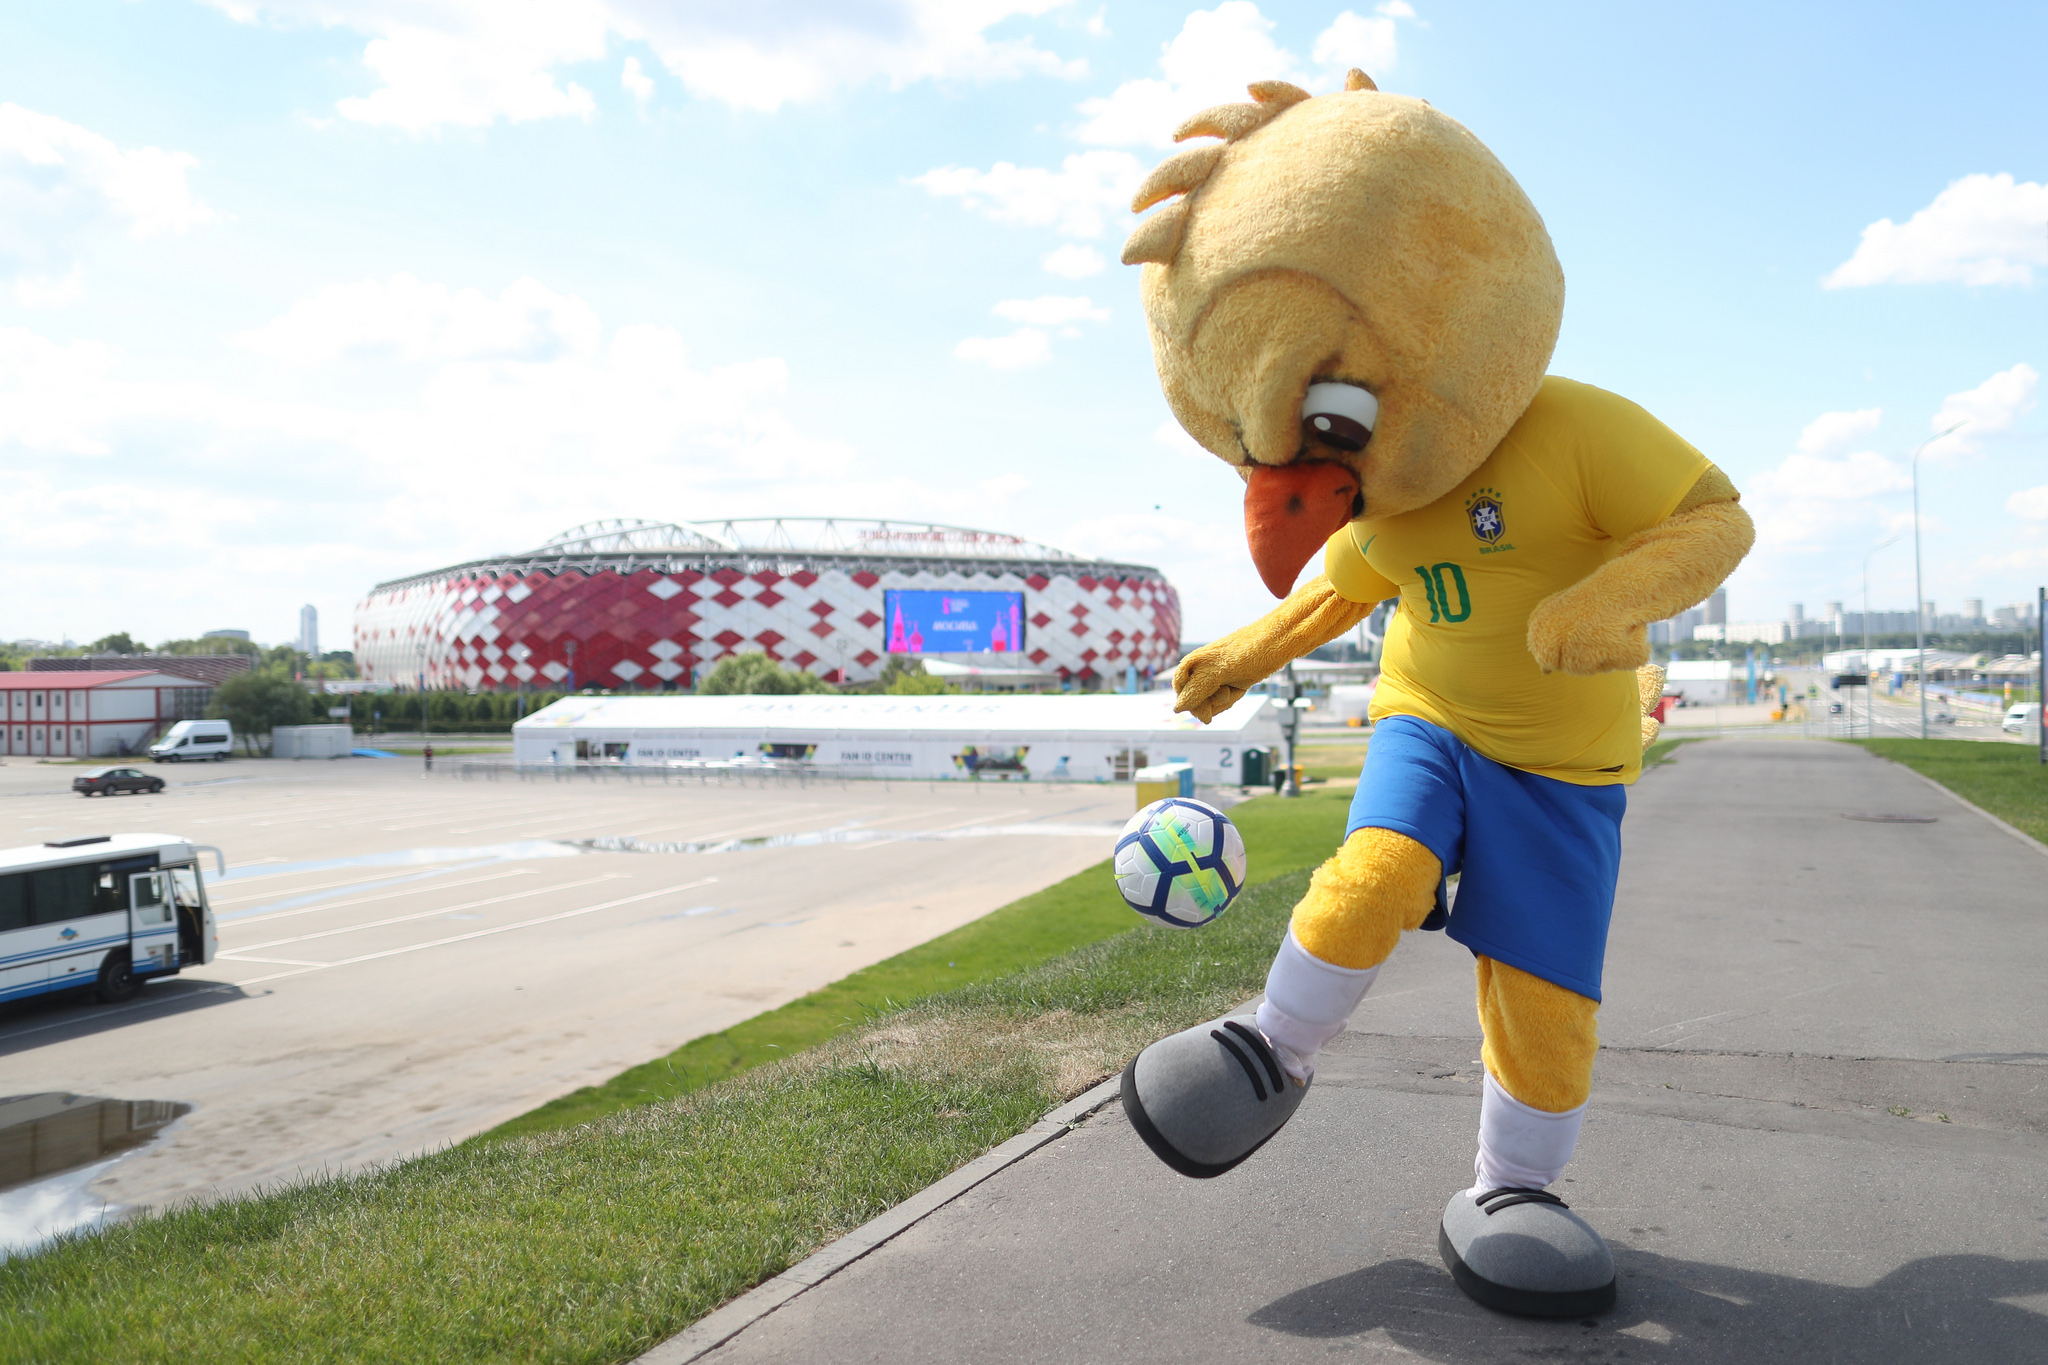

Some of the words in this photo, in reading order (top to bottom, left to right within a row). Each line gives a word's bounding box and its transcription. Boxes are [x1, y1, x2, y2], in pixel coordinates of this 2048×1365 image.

[1480, 515, 1492, 523] CBF
[1479, 544, 1515, 554] BRASIL
[1414, 562, 1471, 622] 10
[637, 747, 654, 758] FAN
[656, 747, 665, 758] ID
[666, 747, 701, 758] CENTER
[840, 751, 859, 762] FAN
[862, 751, 872, 762] ID
[874, 751, 912, 763] CENTER
[1220, 748, 1234, 767] 2
